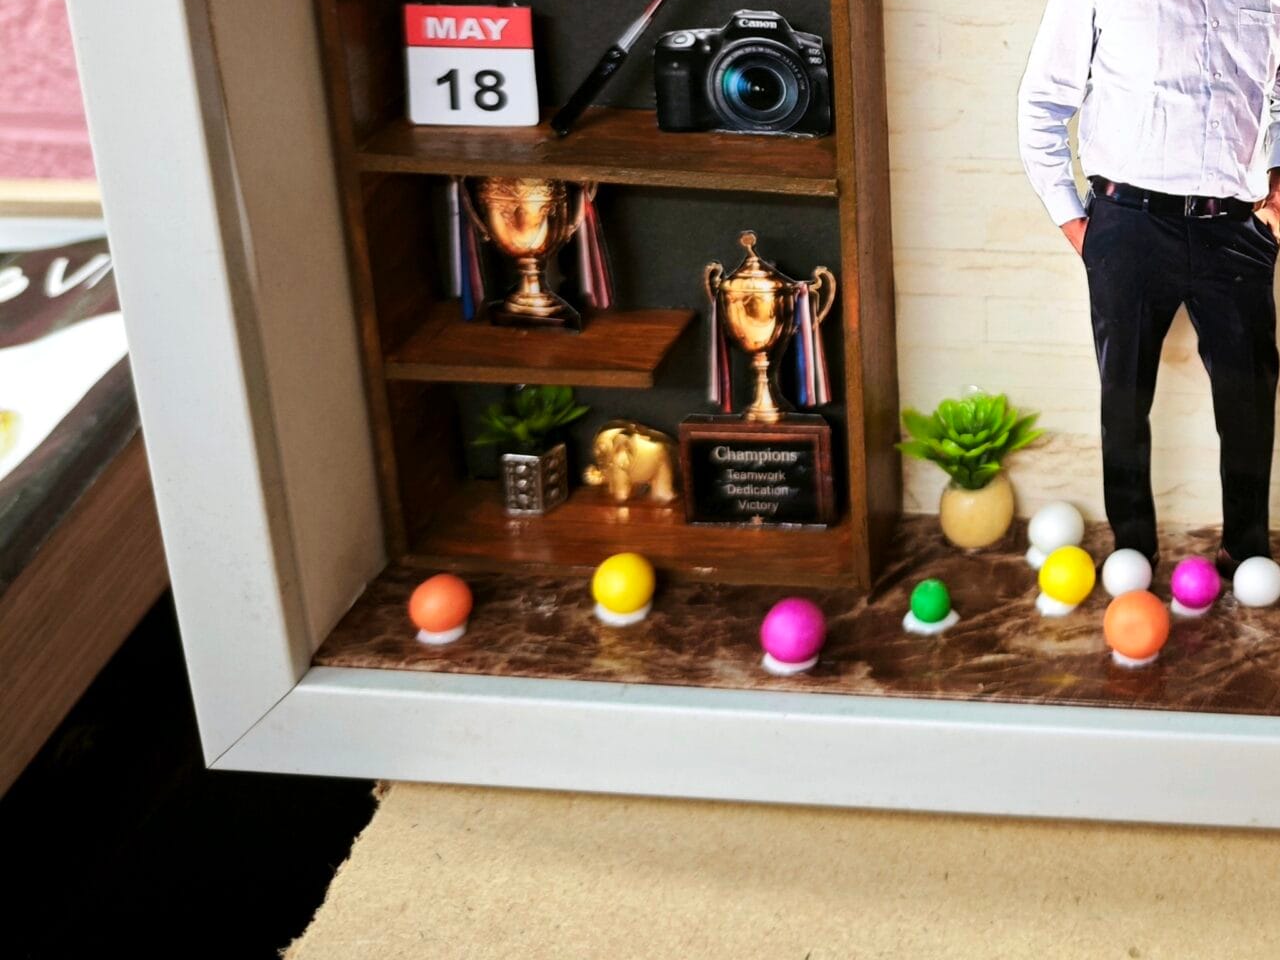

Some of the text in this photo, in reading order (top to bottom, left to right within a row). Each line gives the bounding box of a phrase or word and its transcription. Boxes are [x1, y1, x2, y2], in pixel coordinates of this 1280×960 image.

[423, 16, 509, 41] MAY
[738, 19, 778, 29] Canon
[436, 68, 508, 112] 18
[714, 445, 798, 465] Champions
[726, 468, 786, 481] Teamwork
[726, 484, 789, 496] Dedication
[738, 499, 779, 513] Victory
